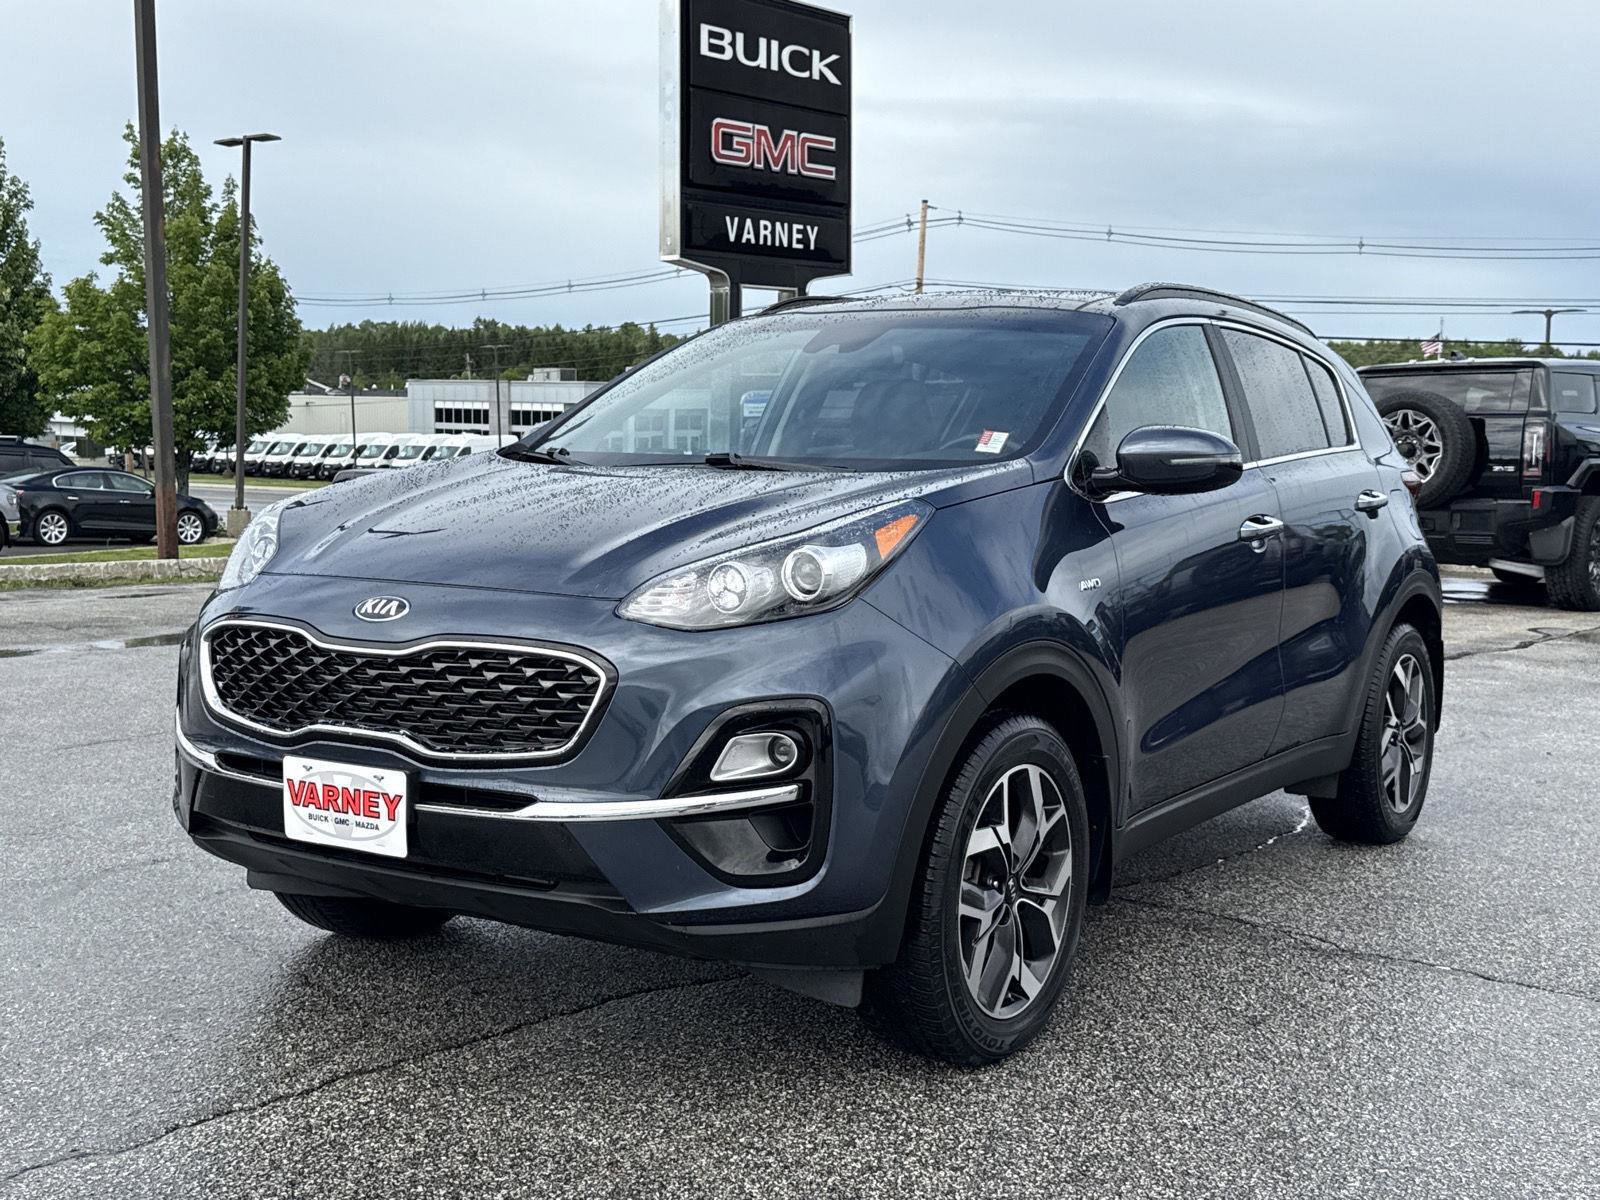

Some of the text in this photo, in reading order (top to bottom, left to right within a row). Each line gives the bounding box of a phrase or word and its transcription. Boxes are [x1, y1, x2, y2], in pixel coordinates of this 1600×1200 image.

[700, 23, 842, 86] BUICK
[711, 117, 836, 181] GMC
[725, 215, 819, 250] VARNEY
[1080, 578, 1101, 591] AWD
[360, 598, 399, 616] KIA
[286, 778, 404, 822] VARNEY
[308, 812, 380, 831] BUICK GMC MAZDA
